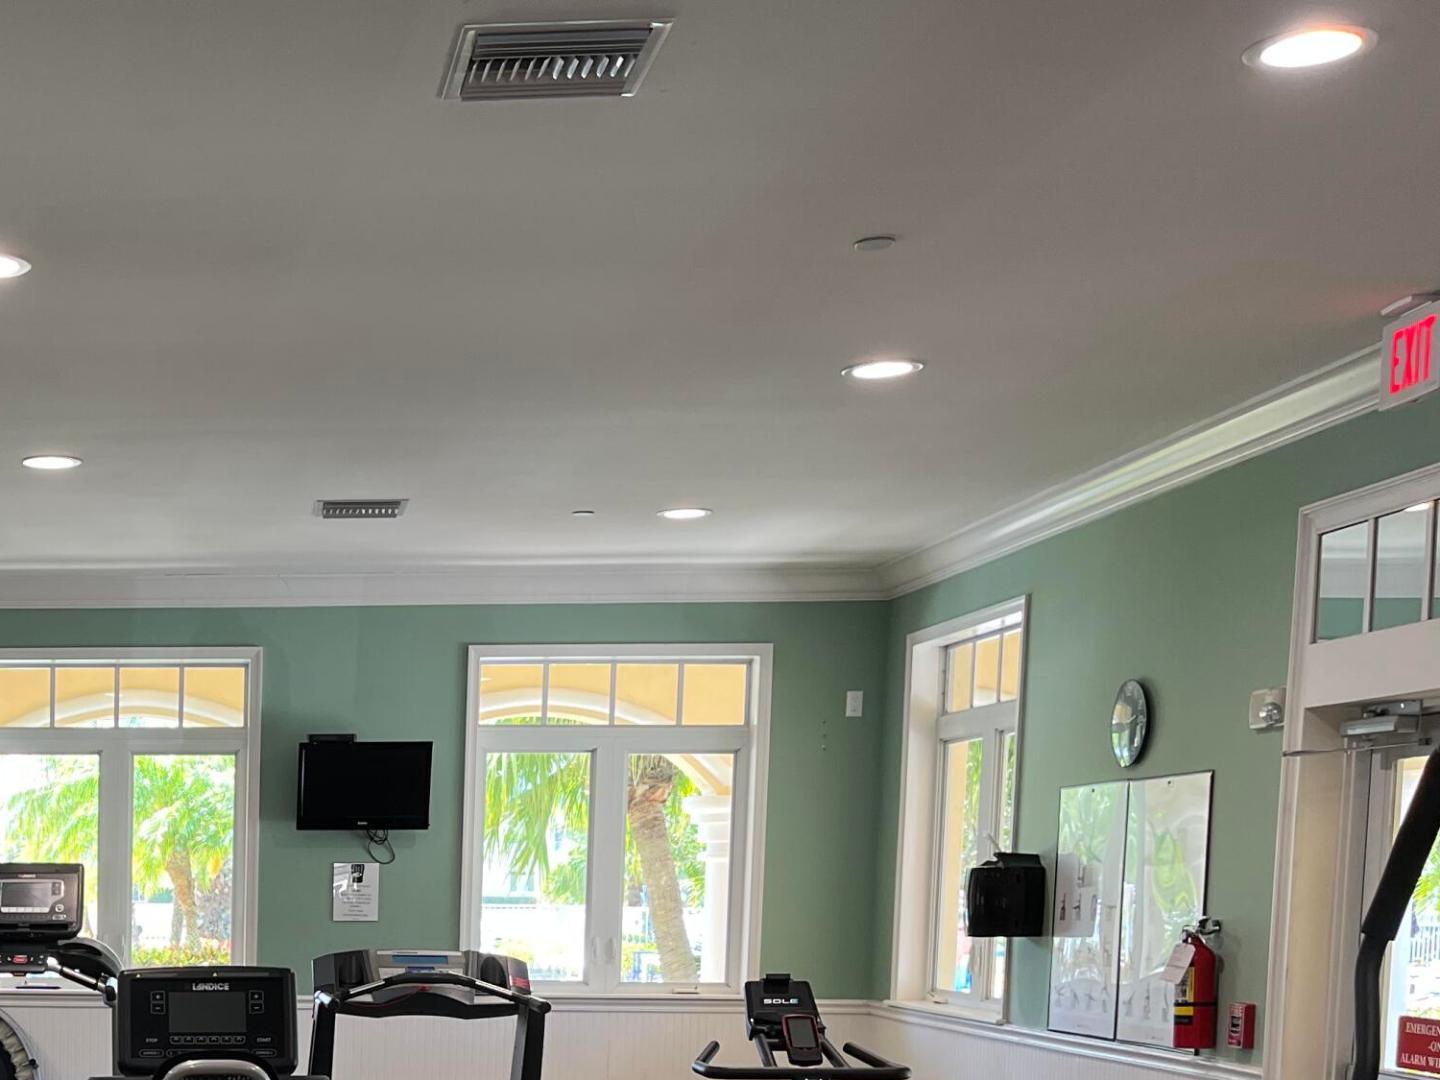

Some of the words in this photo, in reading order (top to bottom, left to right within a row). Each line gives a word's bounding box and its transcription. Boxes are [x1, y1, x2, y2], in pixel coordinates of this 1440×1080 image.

[1390, 315, 1436, 393] EXIT
[192, 983, 230, 991] LANDICE
[1402, 1053, 1426, 1065] ALARM
